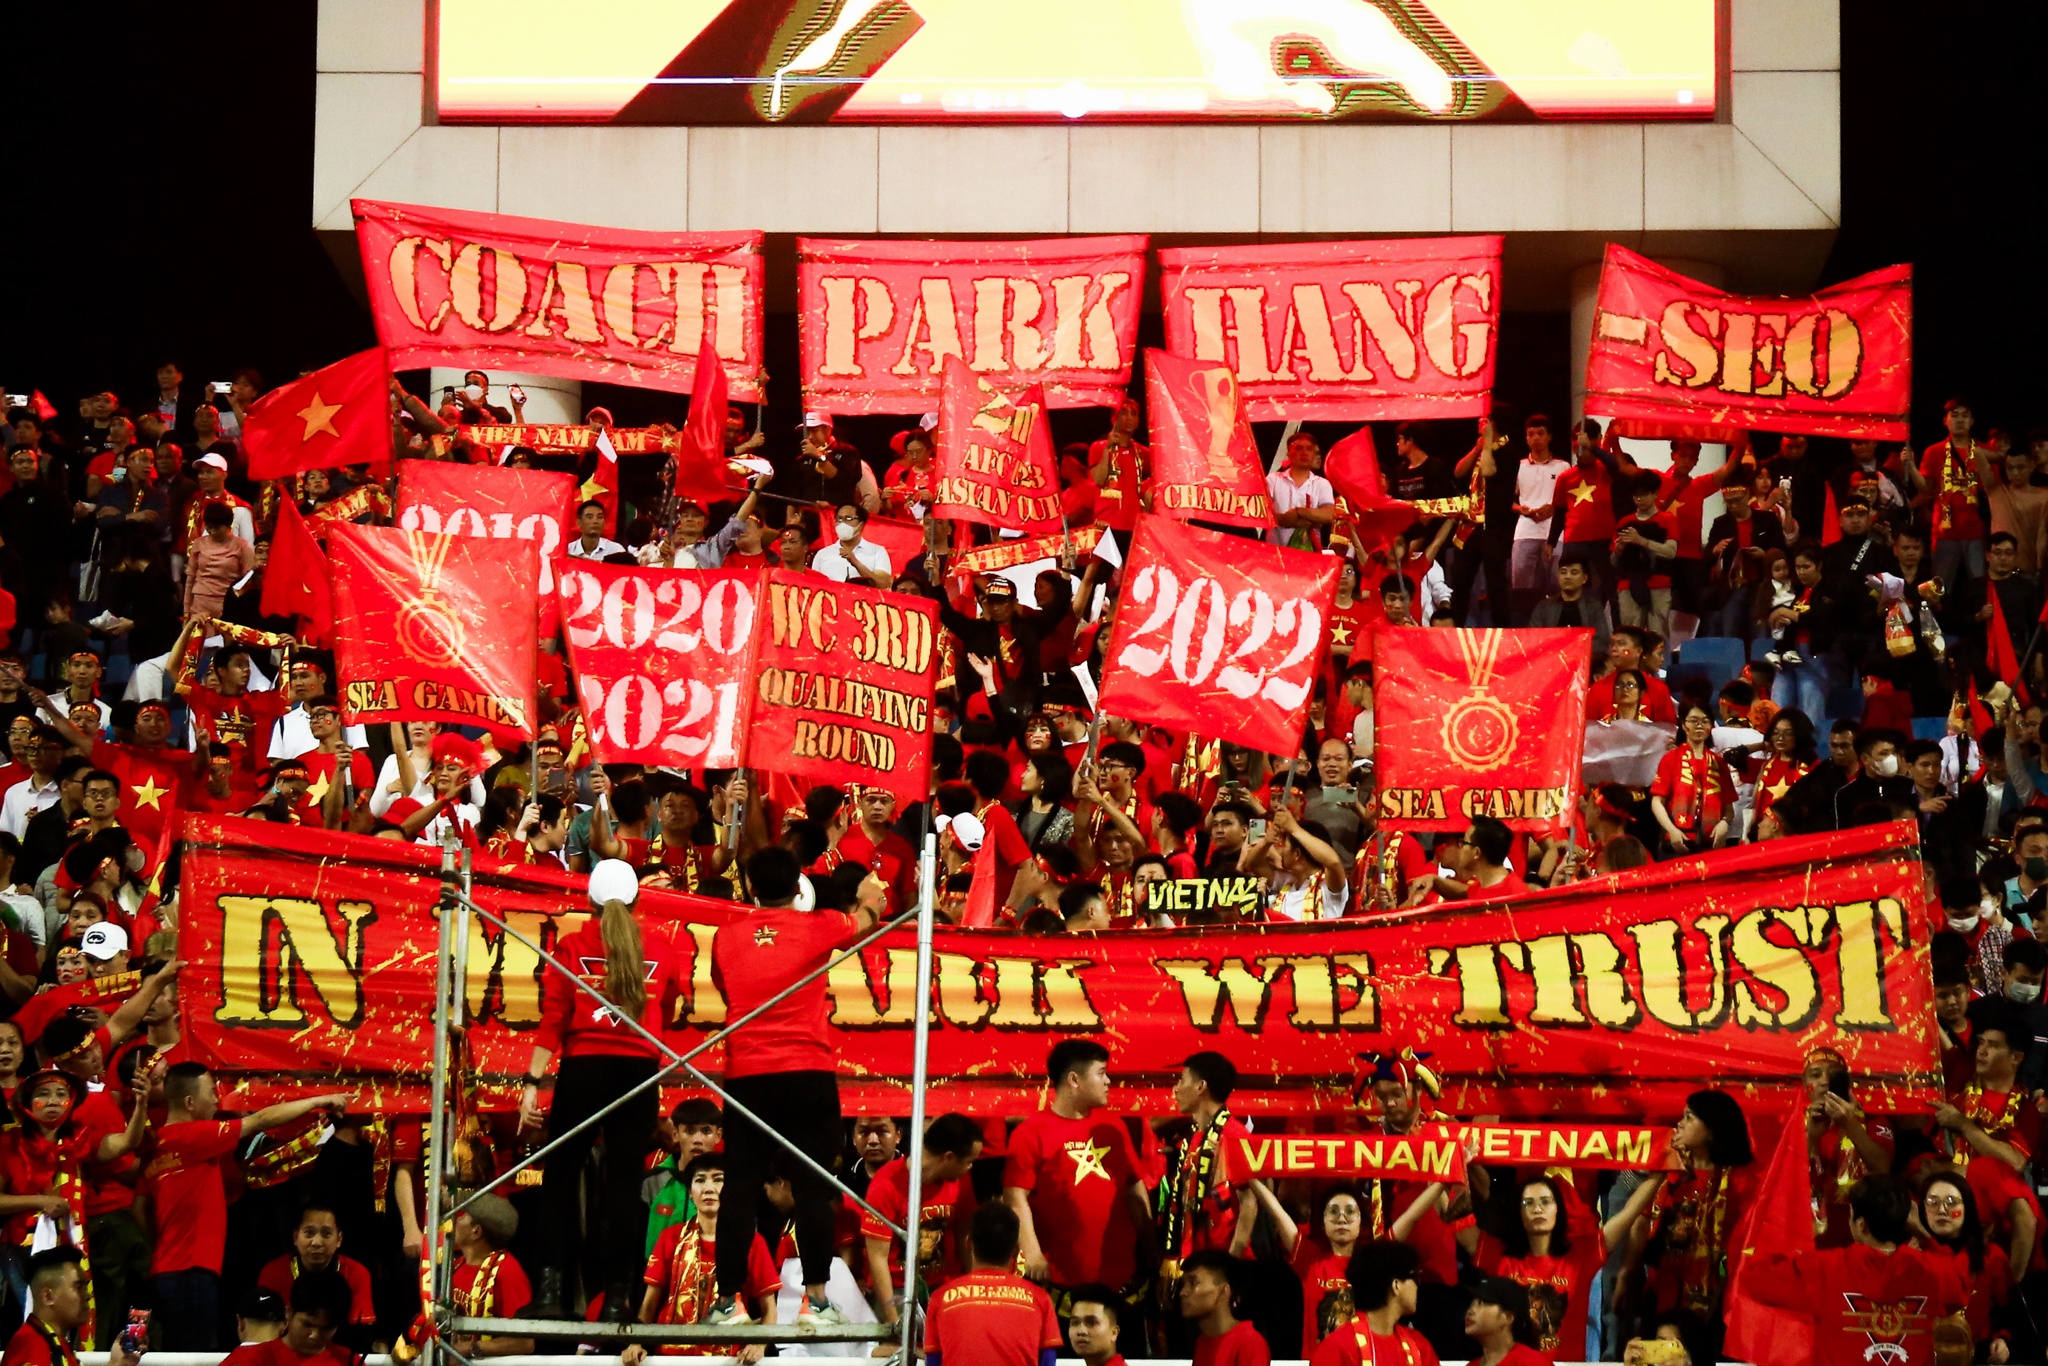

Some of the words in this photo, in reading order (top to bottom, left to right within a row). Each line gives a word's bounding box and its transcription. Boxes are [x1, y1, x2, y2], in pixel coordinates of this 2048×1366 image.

[389, 235, 747, 362] COACH
[819, 272, 1130, 377] PARK
[1184, 273, 1492, 383] HANG
[960, 443, 1013, 479] AFC
[934, 477, 1012, 517] ASIAN
[560, 570, 755, 656] 2020
[769, 582, 838, 653] WC
[852, 599, 933, 675] 3RD
[1118, 564, 1322, 711] 2022
[347, 679, 400, 713] SEA
[413, 680, 526, 728] GAMES
[758, 666, 929, 734] QUALIFYING
[791, 719, 897, 772] ROUND
[1380, 788, 1448, 820] SEA
[213, 895, 379, 1029] IN
[1155, 952, 1381, 1034] WE
[1427, 896, 1912, 1032] TRUST
[1238, 1139, 1346, 1172] VIET
[1354, 1140, 1457, 1176] NAM
[1548, 1130, 1652, 1164] NAM
[943, 1284, 986, 1303] ONE
